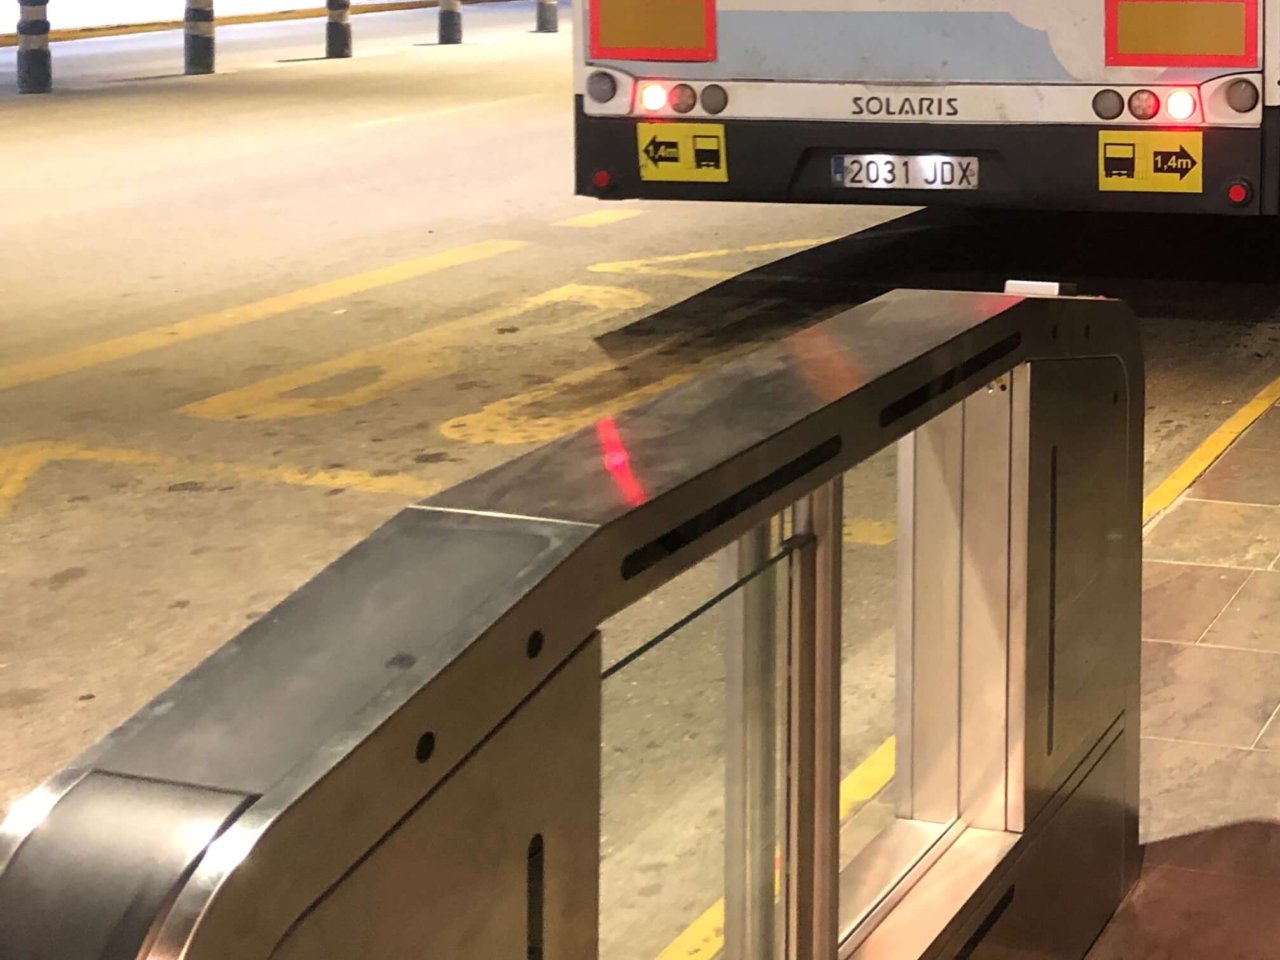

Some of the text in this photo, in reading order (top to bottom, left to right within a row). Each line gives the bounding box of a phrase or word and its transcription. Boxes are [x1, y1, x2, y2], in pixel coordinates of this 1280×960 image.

[851, 96, 959, 116] SOLARIS
[1155, 155, 1192, 170] 1,4m
[849, 160, 972, 186] 2031 JDX
